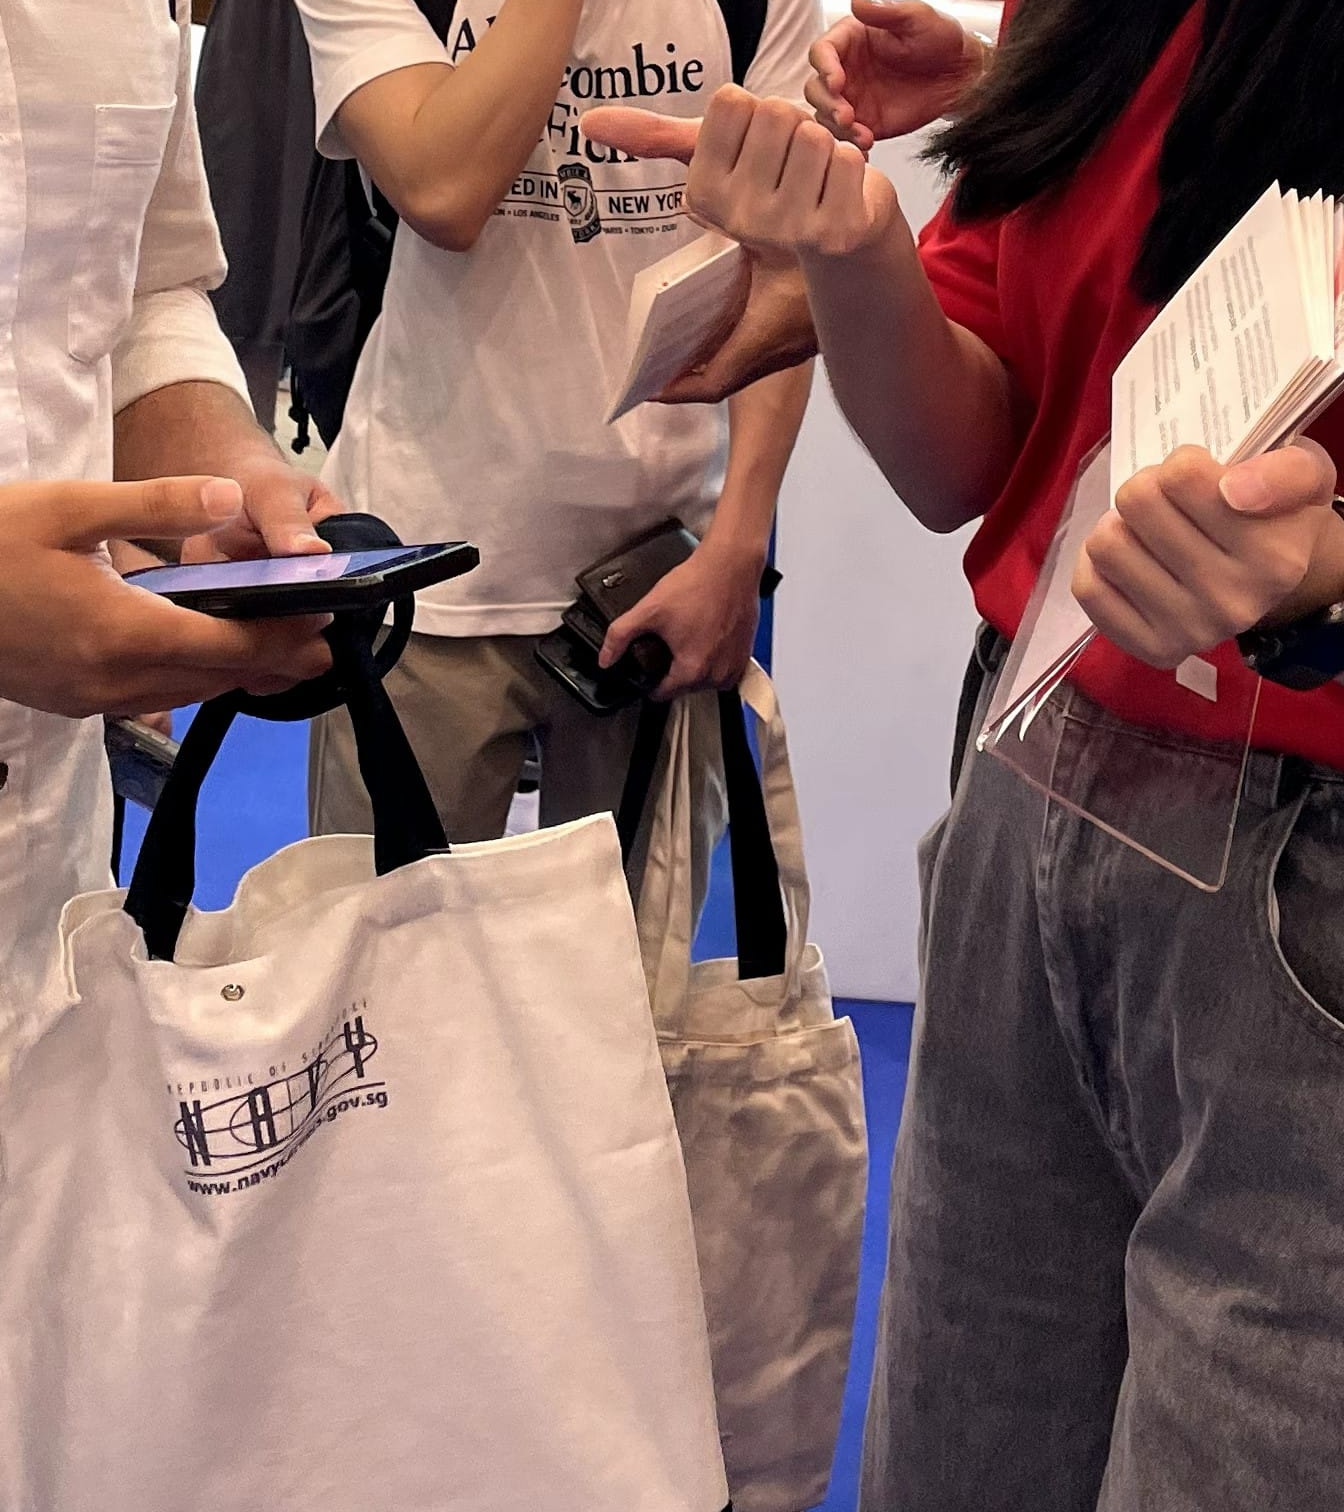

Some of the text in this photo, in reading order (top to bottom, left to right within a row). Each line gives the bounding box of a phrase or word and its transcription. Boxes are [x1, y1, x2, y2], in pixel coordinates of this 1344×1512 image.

[541, 180, 558, 200] IN
[609, 196, 649, 214] NEW
[656, 191, 683, 211] YOR
